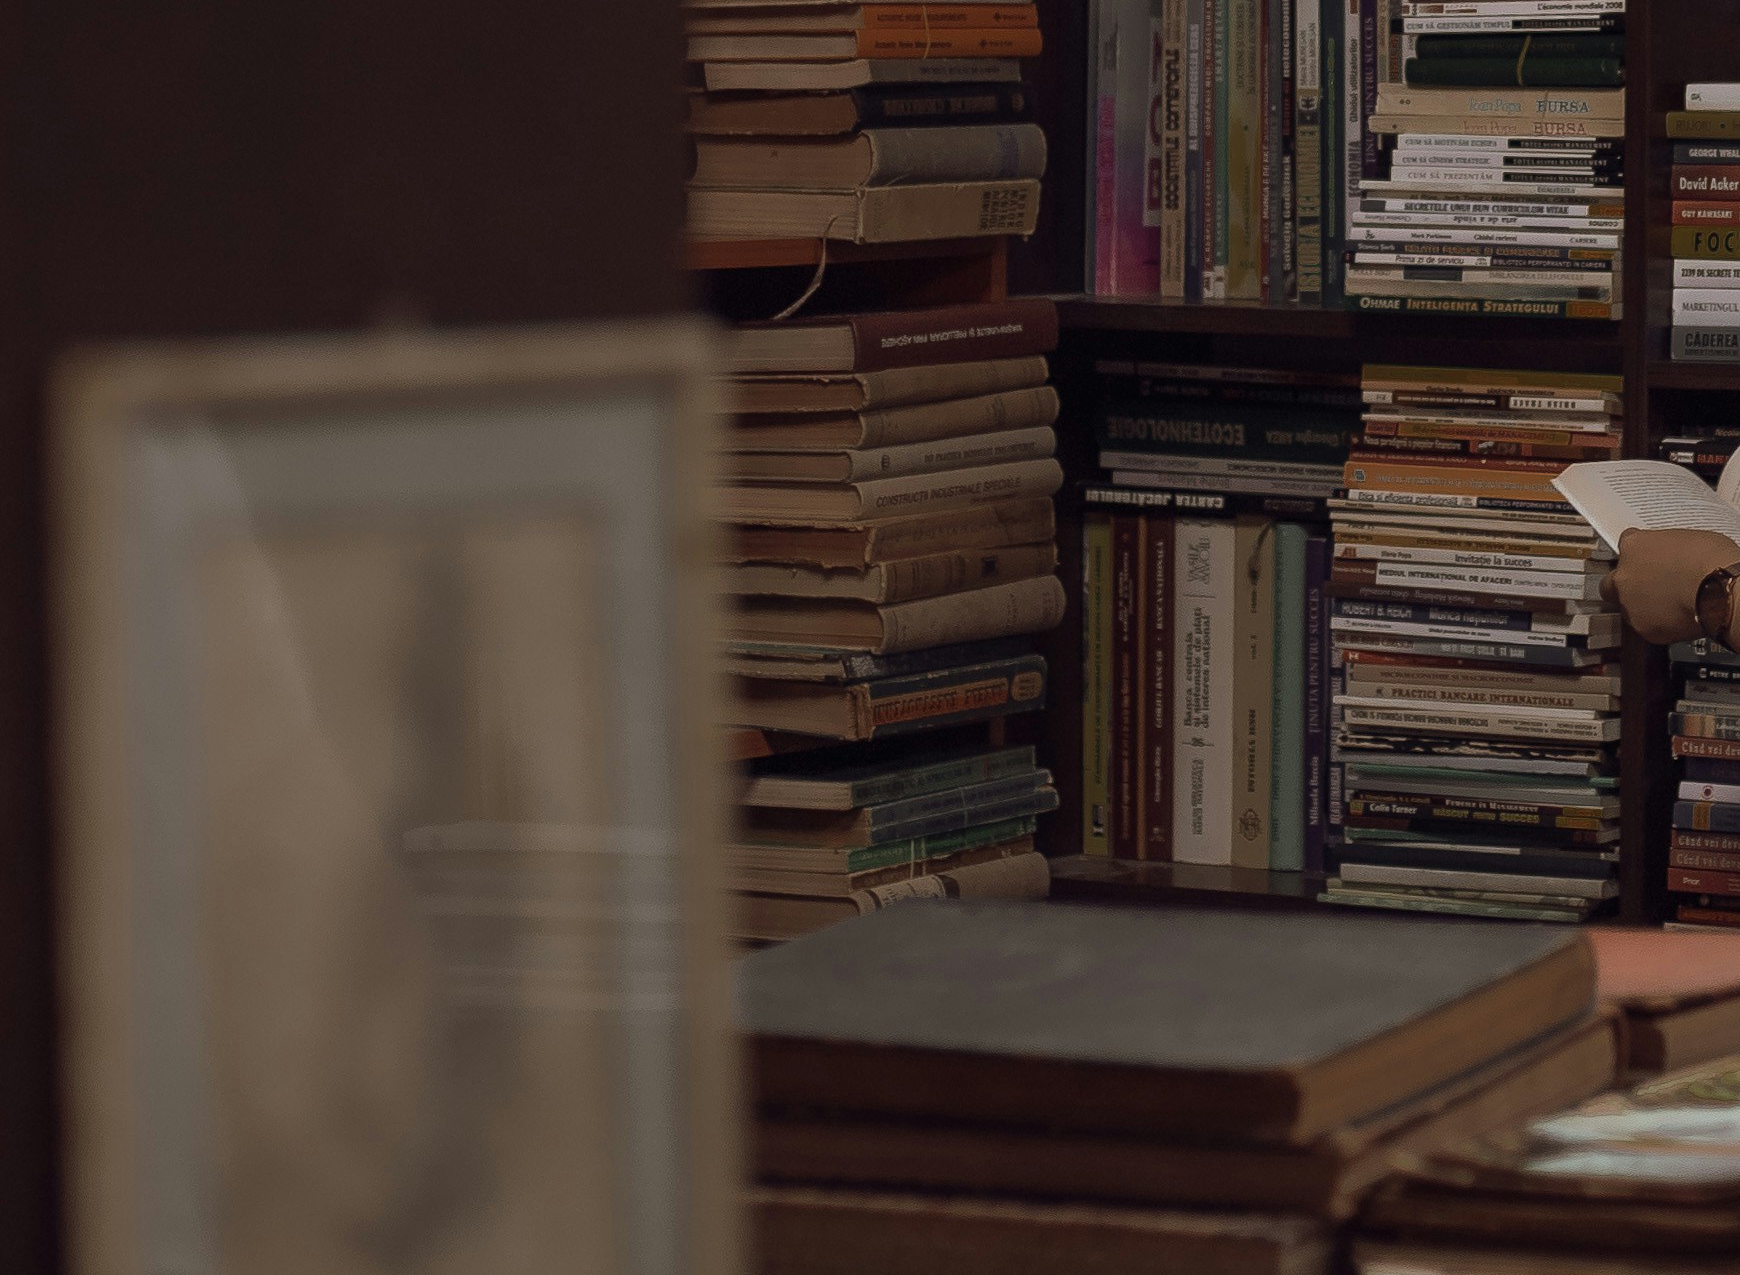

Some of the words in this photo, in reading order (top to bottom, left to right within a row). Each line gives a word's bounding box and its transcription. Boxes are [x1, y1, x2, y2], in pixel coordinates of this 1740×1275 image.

[1536, 100, 1589, 113] BURSA
[1533, 121, 1587, 135] BURSA
[1680, 177, 1708, 190] David
[1710, 178, 1739, 191] Aaker
[1360, 297, 1400, 309] OHMAE
[1682, 302, 1739, 313] MARKETINGUL
[1685, 331, 1739, 347] CĂDEREA
